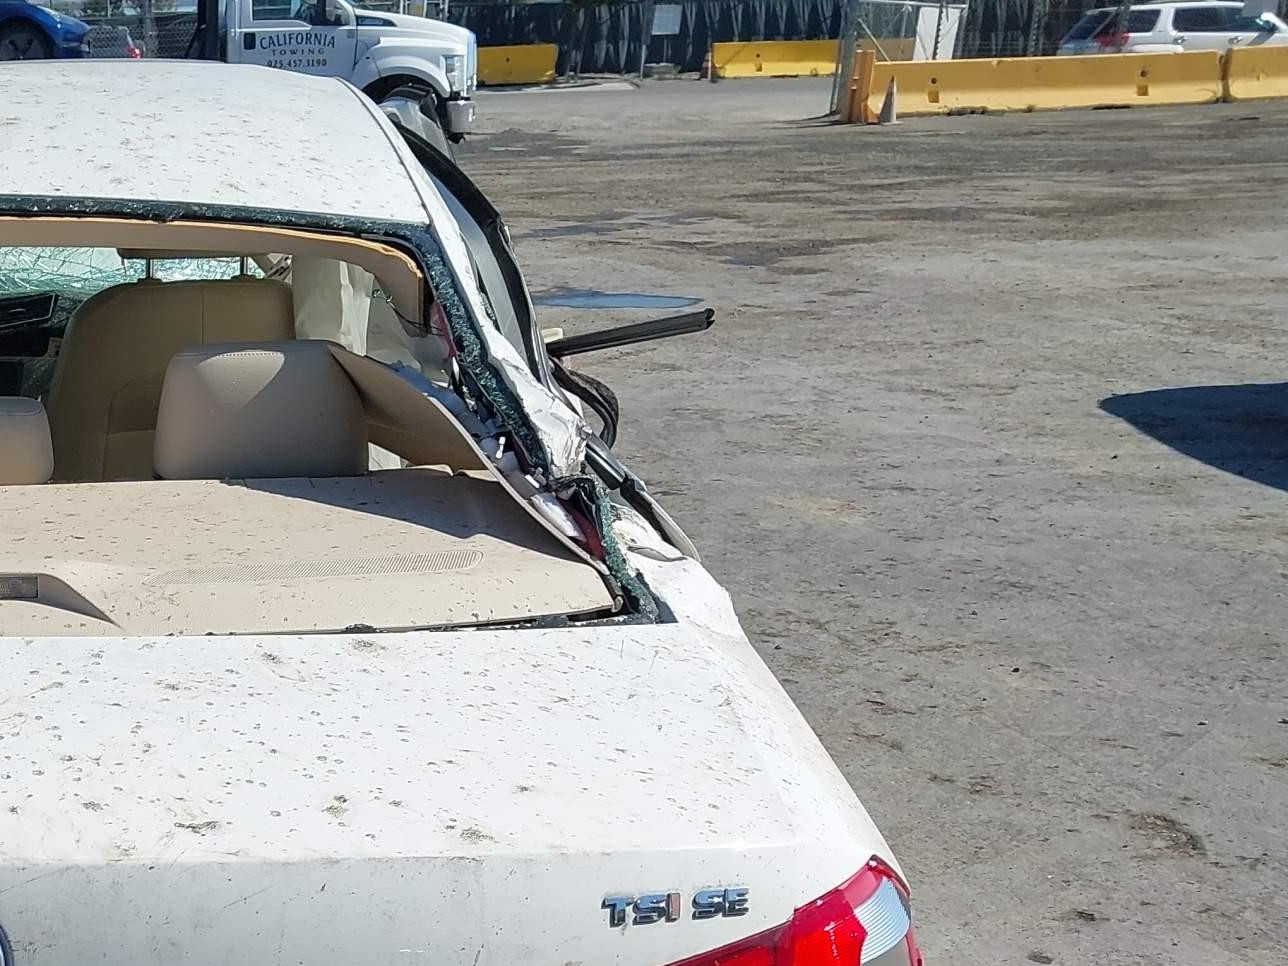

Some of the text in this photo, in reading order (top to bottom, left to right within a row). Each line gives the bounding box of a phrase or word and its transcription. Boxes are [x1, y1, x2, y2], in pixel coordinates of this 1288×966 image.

[260, 32, 335, 50] CALIFORNIA
[272, 48, 325, 56] TOWING
[601, 887, 750, 928] TSI SE
